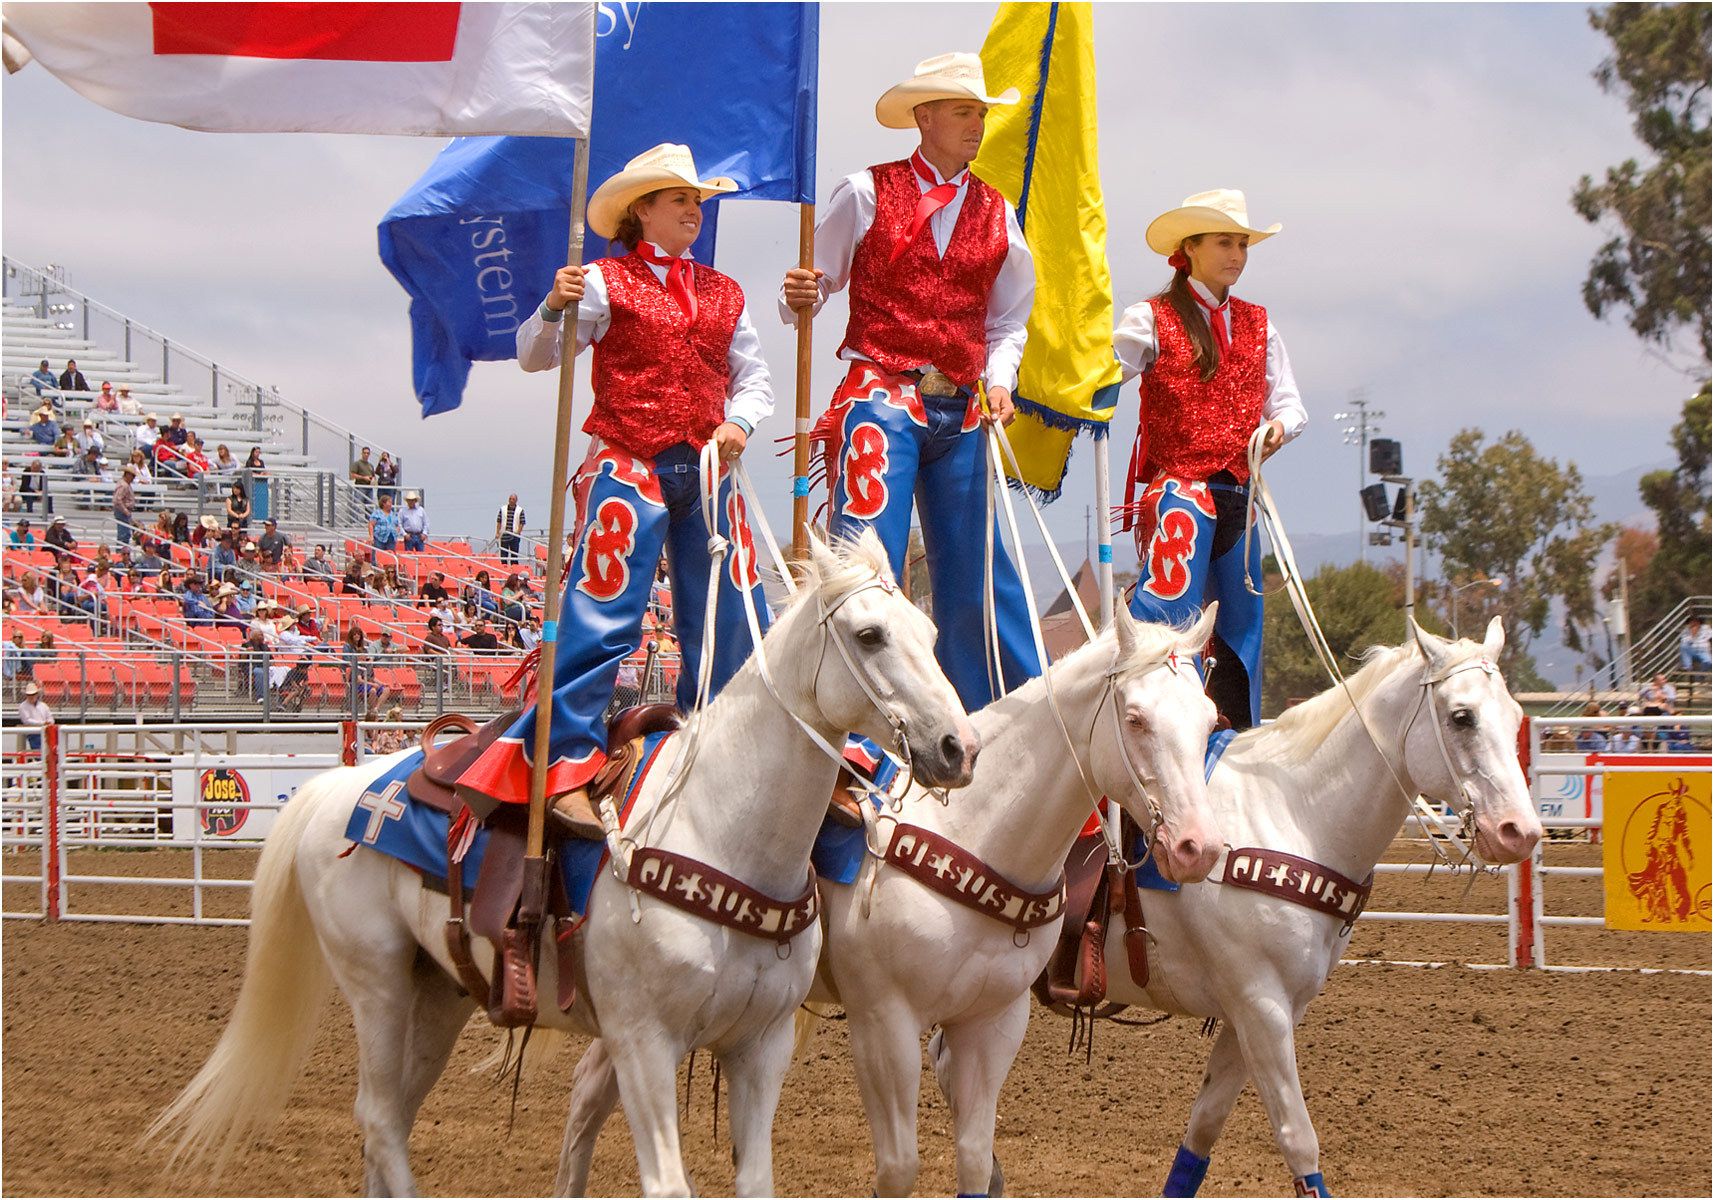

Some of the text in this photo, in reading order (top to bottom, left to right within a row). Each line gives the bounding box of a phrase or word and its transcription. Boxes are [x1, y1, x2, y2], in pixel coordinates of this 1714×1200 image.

[1540, 803, 1563, 817] FM
[641, 857, 764, 932] JESUS
[896, 835, 1008, 917] JESUS
[1233, 856, 1345, 910] JESUS
